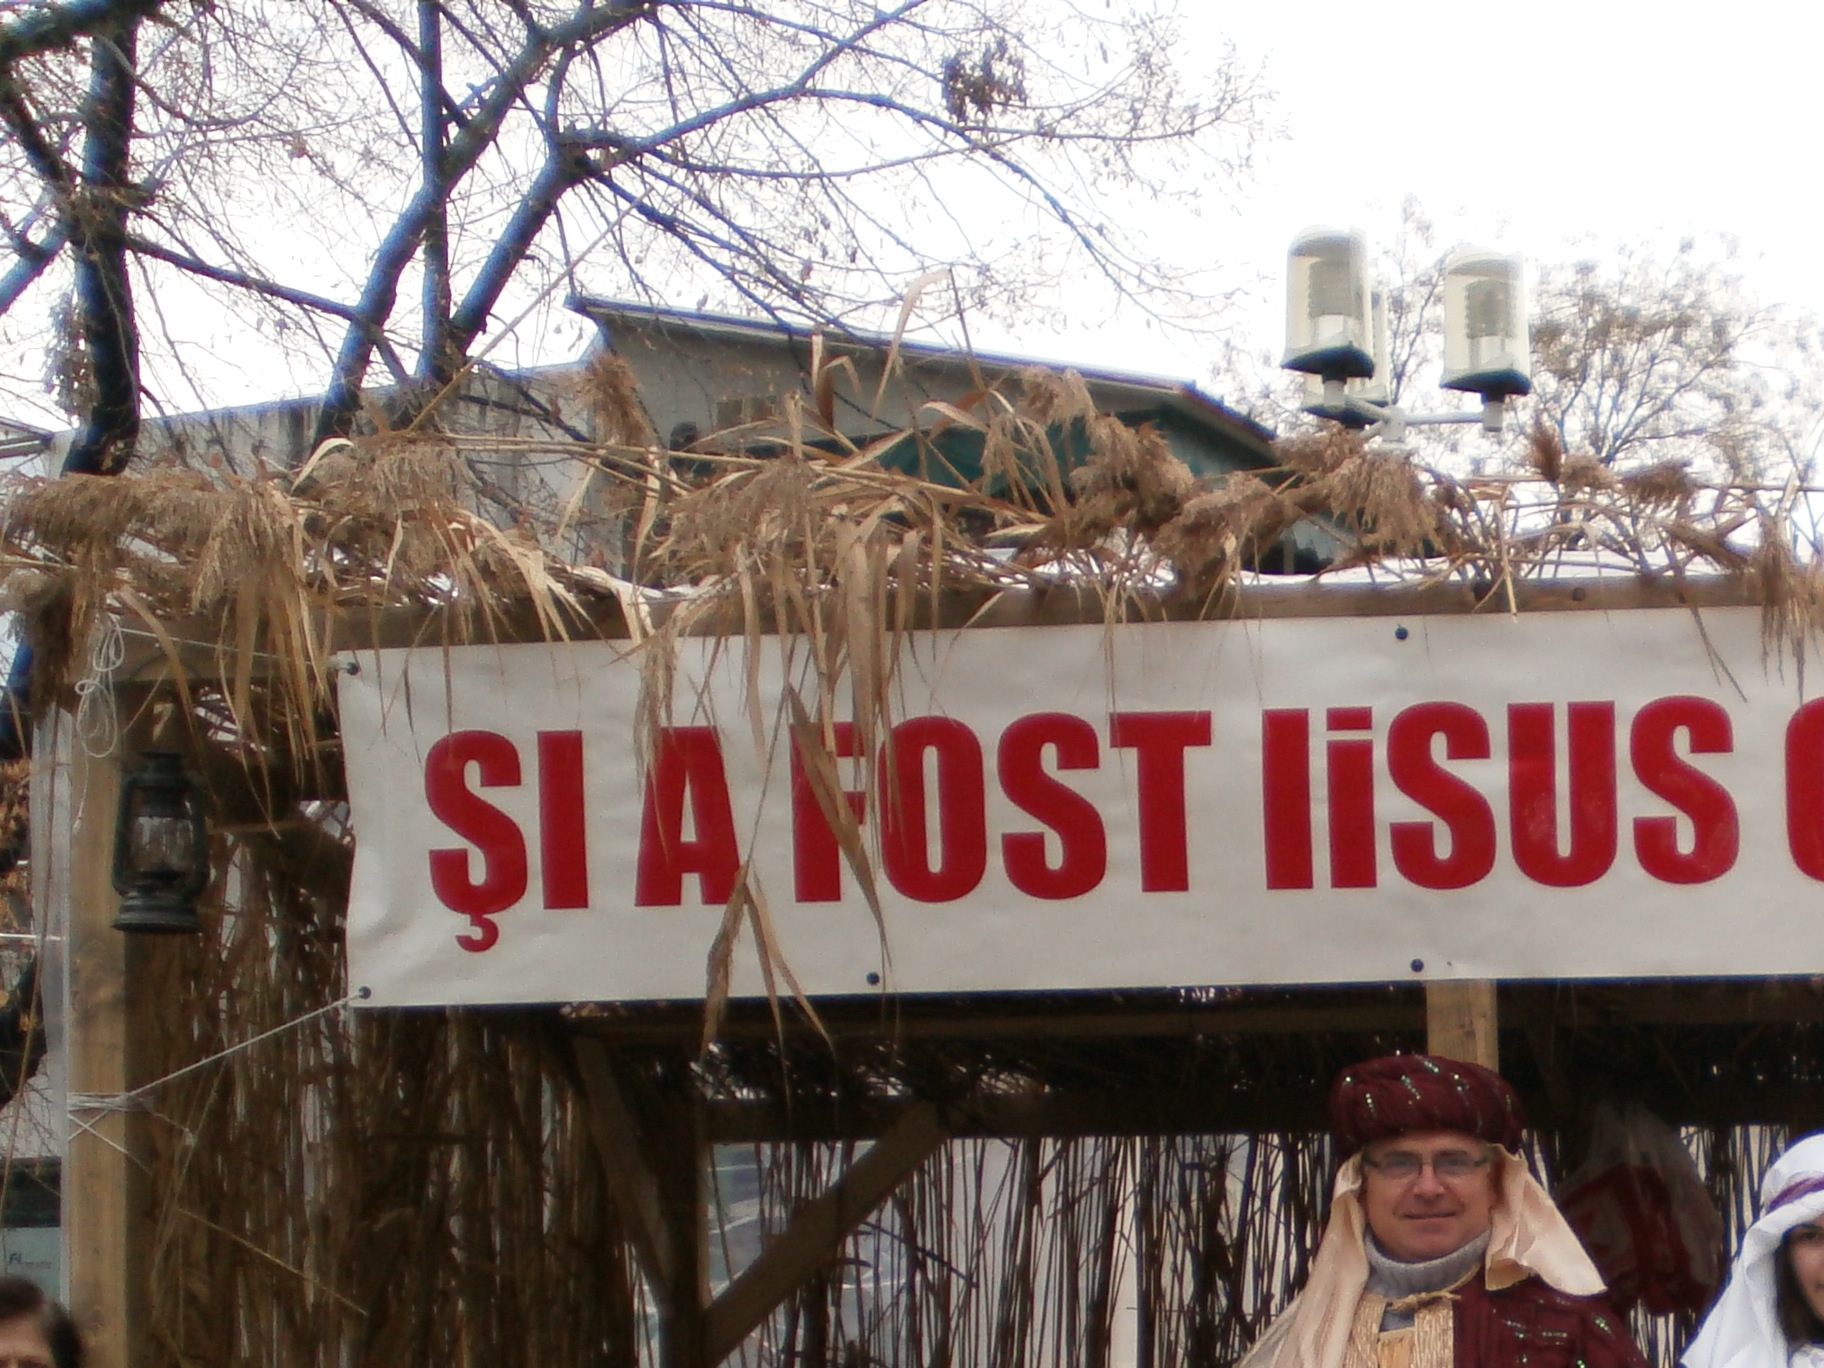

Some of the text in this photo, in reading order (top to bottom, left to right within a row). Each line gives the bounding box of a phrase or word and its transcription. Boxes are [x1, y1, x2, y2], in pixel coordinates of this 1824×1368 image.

[424, 730, 589, 954] ŞI
[634, 726, 756, 907] A
[789, 712, 1212, 904] FOST
